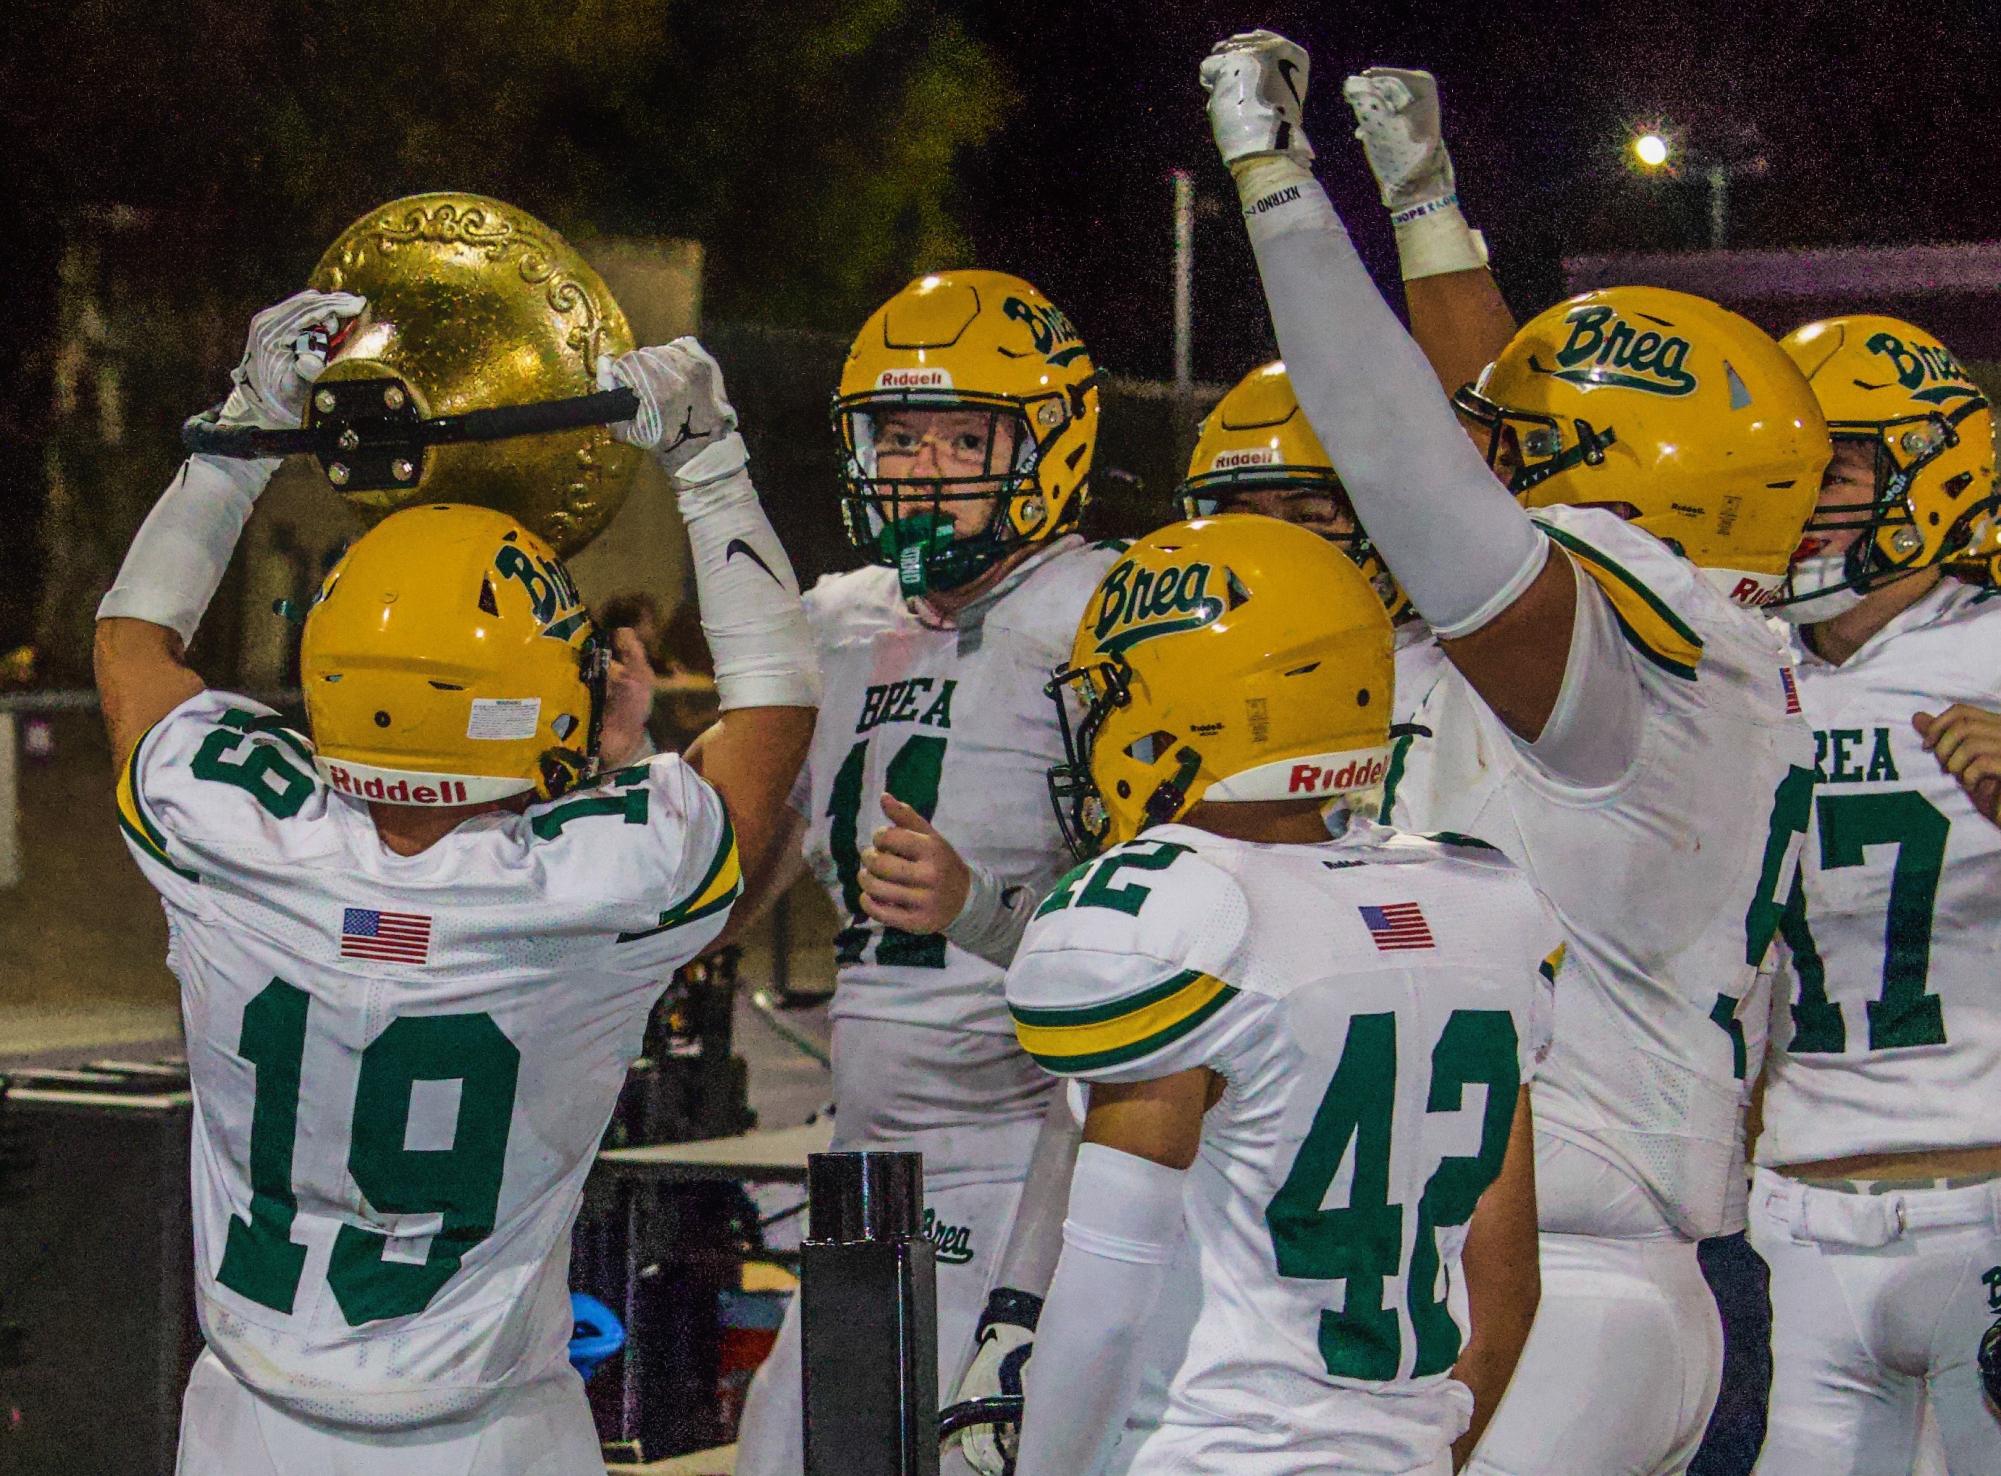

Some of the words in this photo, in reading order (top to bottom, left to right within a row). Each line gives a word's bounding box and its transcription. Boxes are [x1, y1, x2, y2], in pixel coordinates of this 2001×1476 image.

[881, 372, 942, 386] Riddell
[1553, 305, 1697, 396] Brea
[1215, 453, 1273, 469] Riddell
[1095, 560, 1223, 653] Brea
[329, 765, 467, 803] Riddell
[1778, 790, 1951, 1054] 17
[214, 976, 520, 1327] 19
[1264, 1009, 1521, 1382] 42
